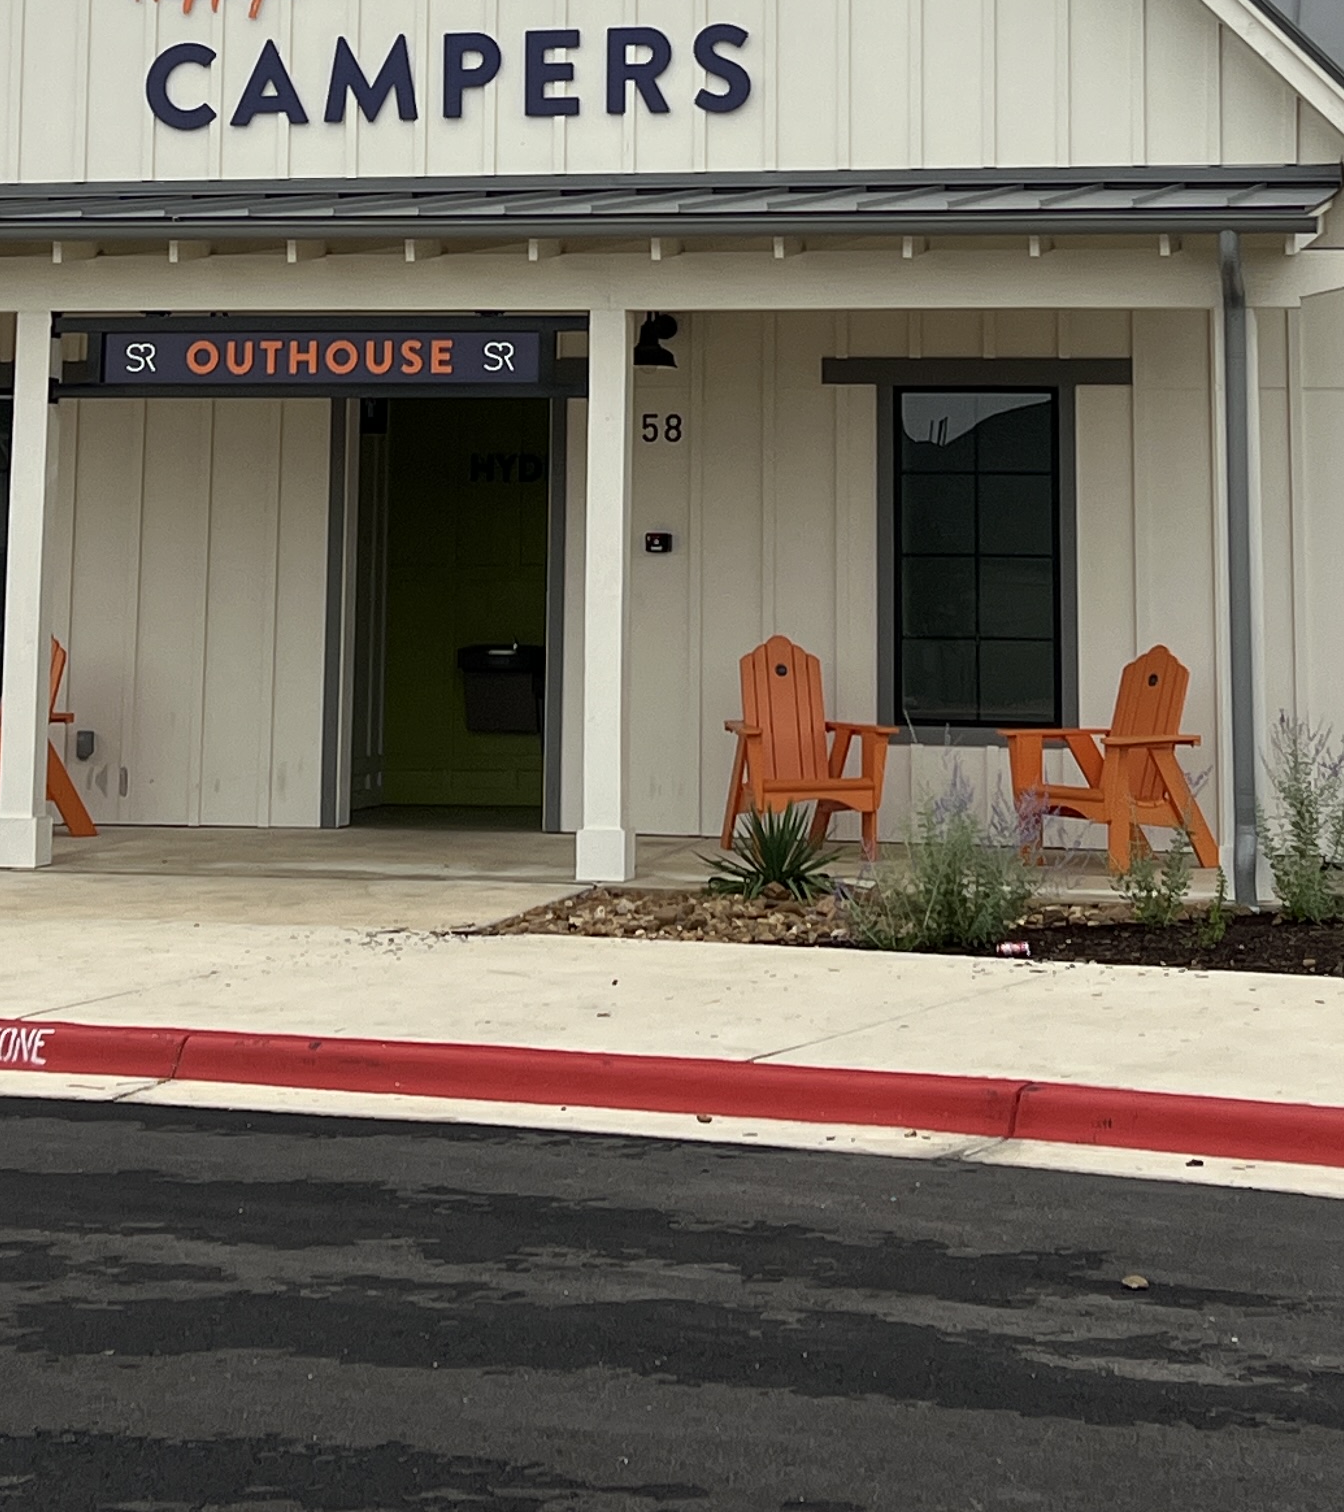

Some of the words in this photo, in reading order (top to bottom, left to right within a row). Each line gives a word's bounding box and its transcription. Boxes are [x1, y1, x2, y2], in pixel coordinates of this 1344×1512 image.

[145, 23, 753, 133] CAMPERS
[186, 339, 453, 375] OUTHOUSE
[641, 412, 683, 443] 58
[468, 451, 548, 483] HYD
